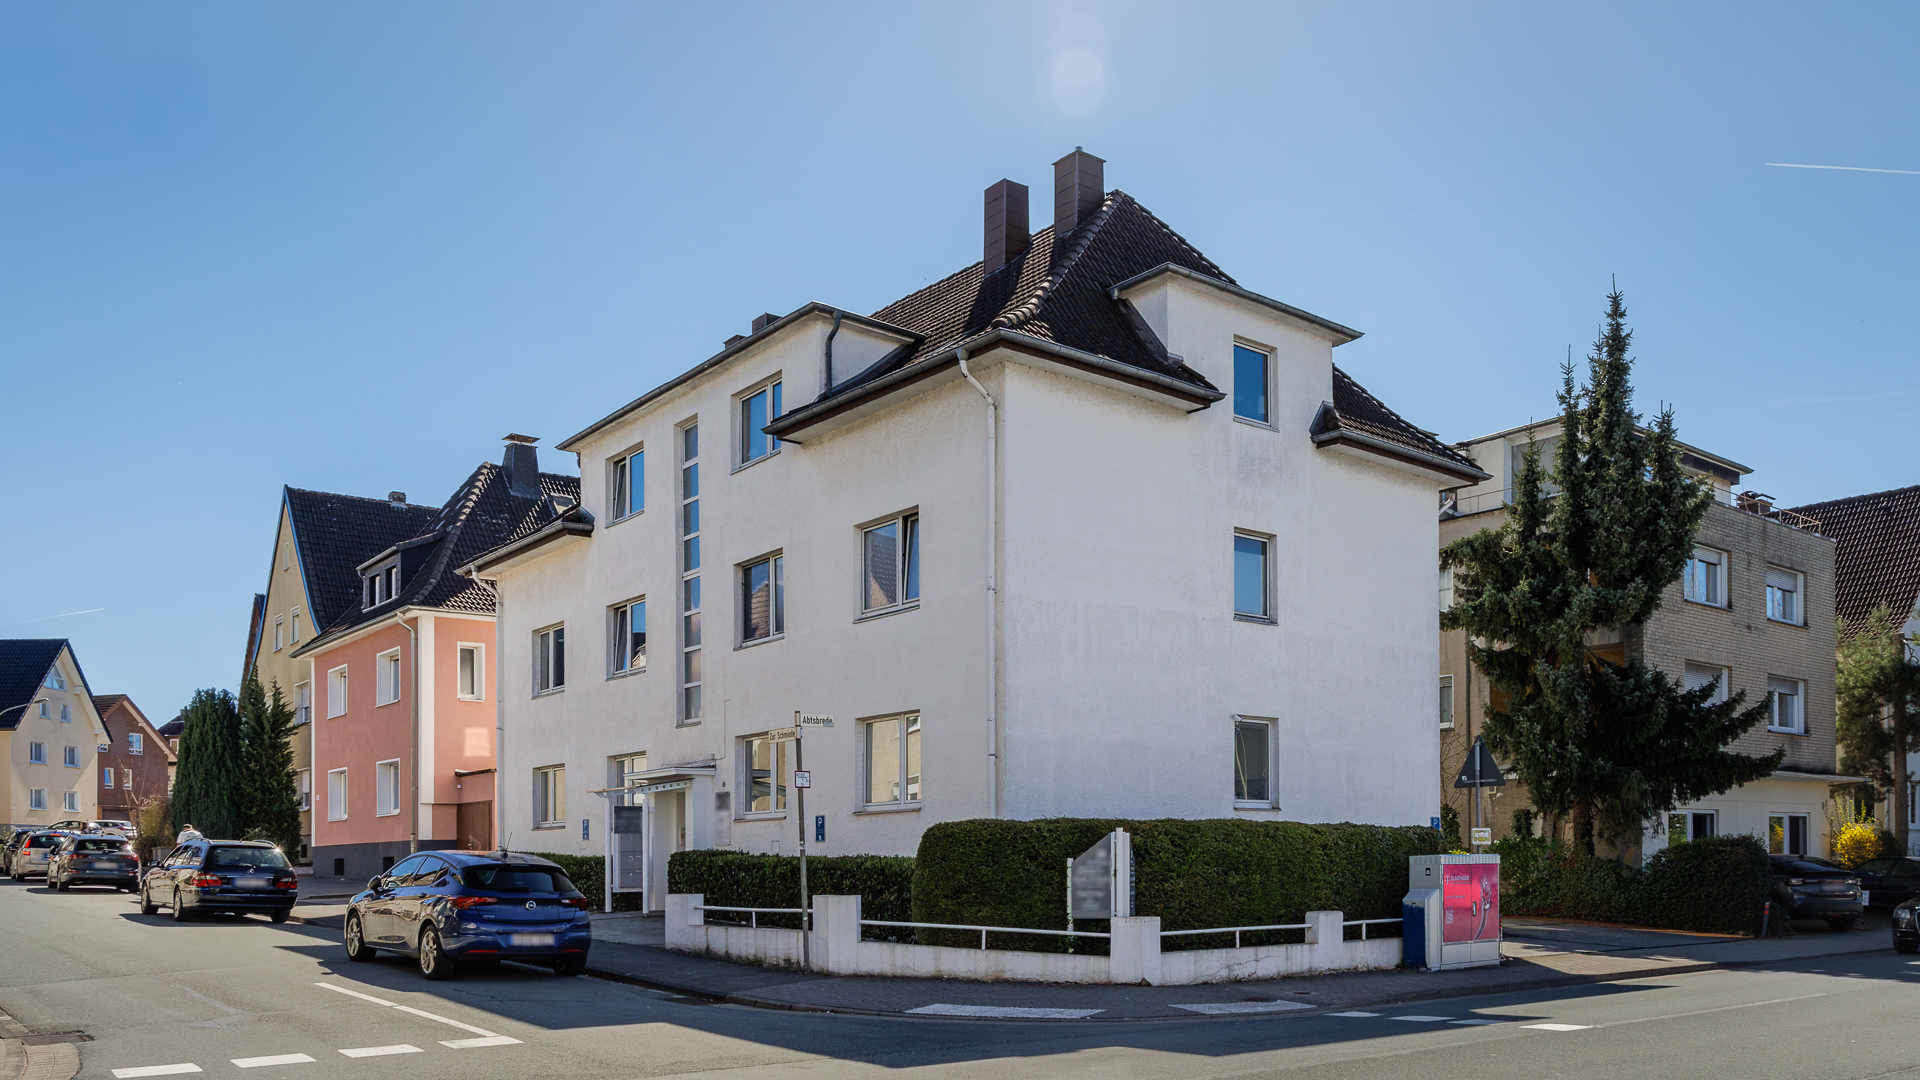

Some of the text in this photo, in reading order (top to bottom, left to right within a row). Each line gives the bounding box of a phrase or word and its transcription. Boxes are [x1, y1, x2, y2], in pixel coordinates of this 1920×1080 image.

[802, 715, 833, 724] Abtsbrede
[777, 730, 796, 740] Schmiede
[817, 817, 823, 828] P
